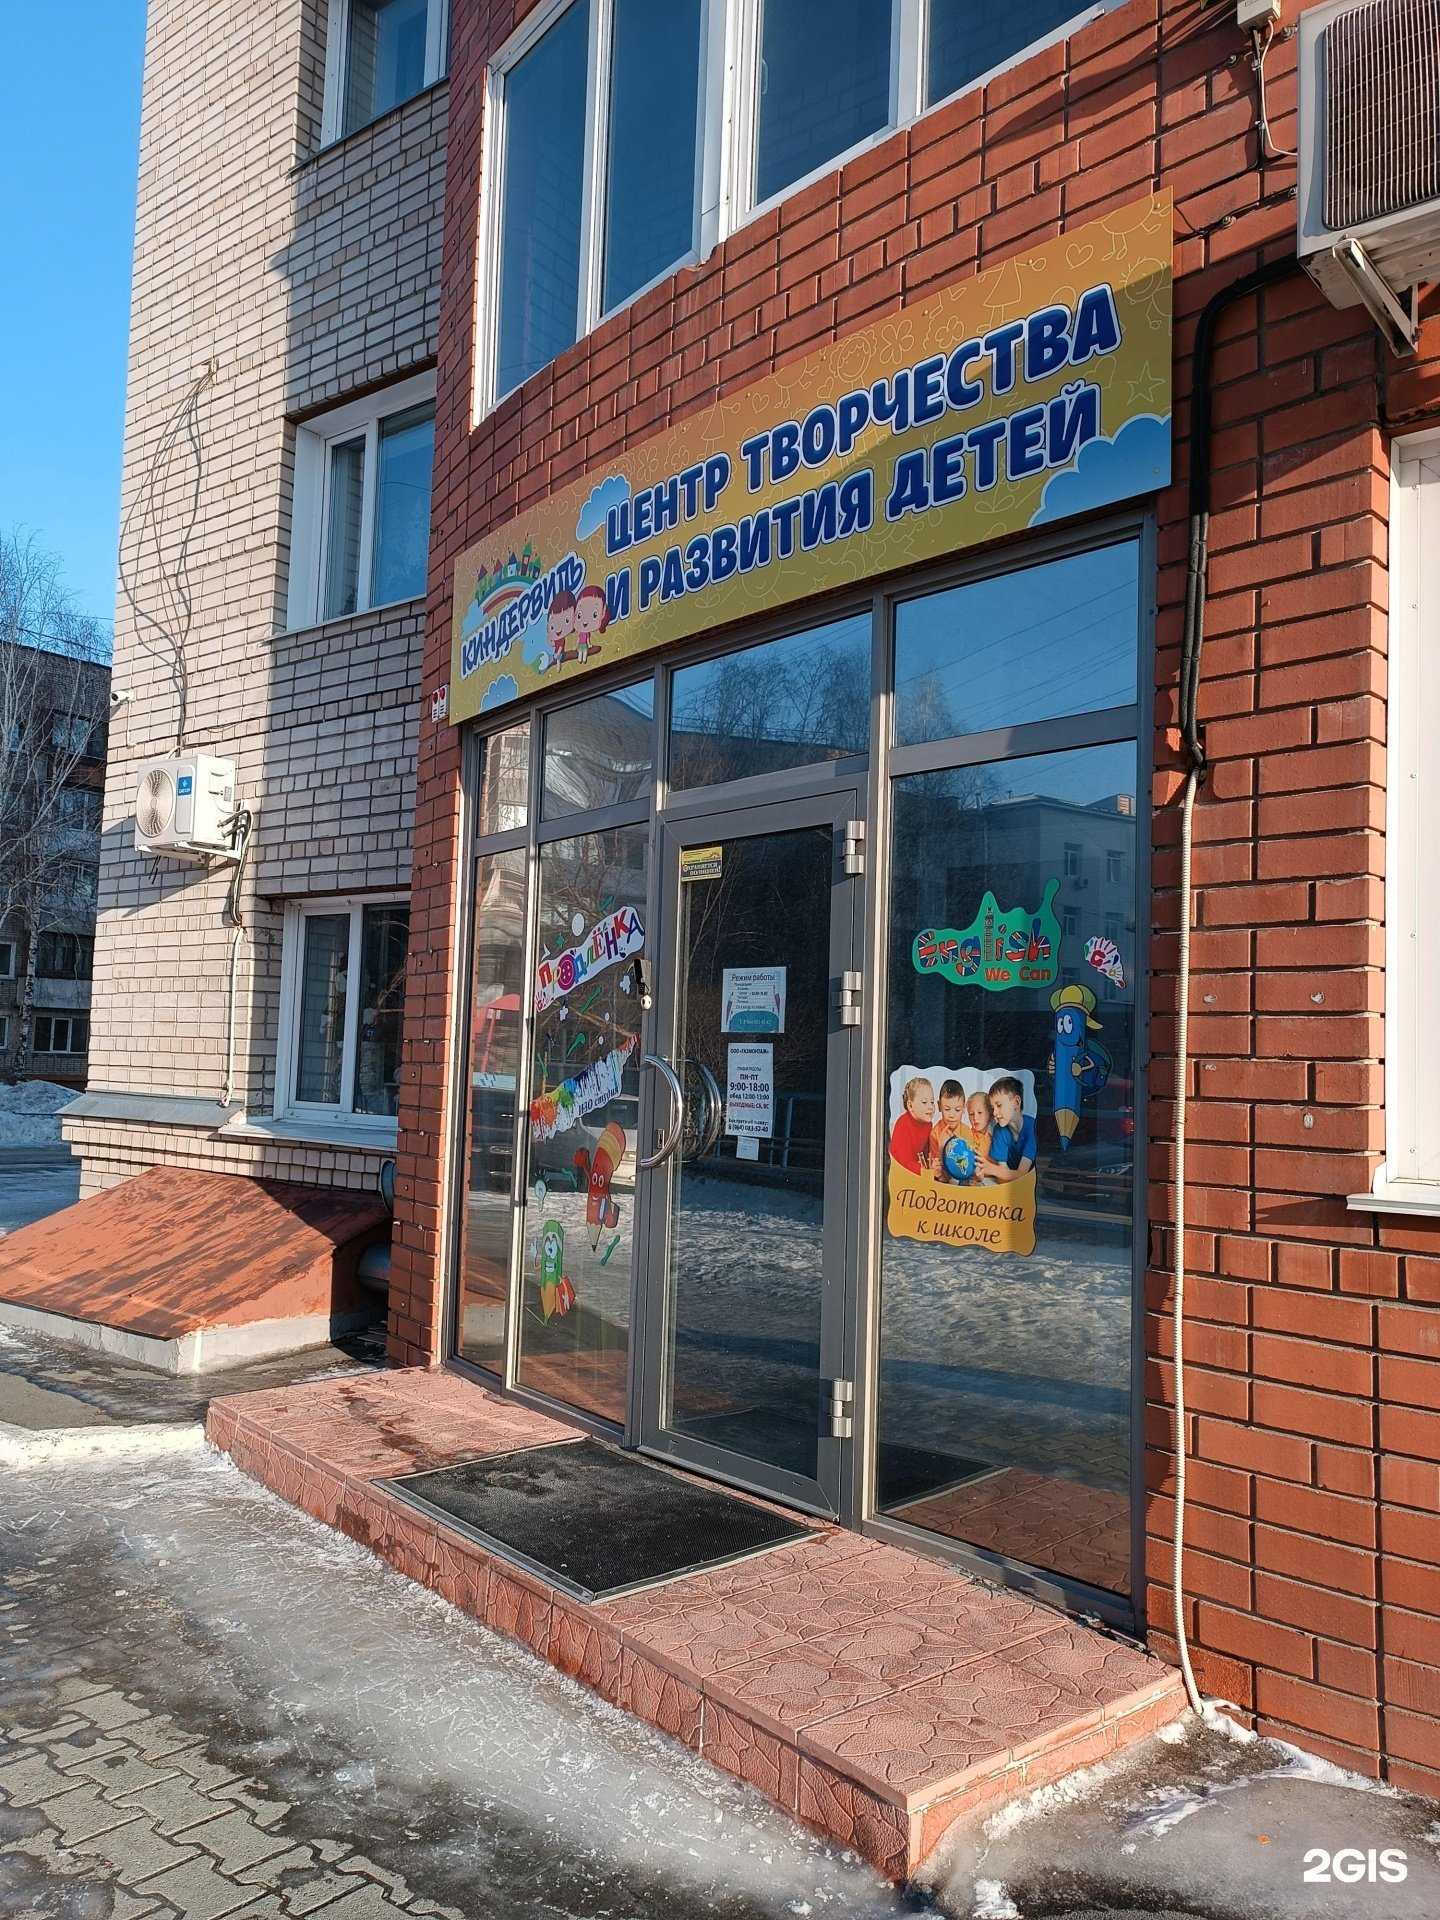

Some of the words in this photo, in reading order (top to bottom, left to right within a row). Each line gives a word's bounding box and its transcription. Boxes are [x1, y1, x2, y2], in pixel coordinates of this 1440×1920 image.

[606, 453, 731, 558] ЦЕНТР
[740, 282, 1122, 493] ТВОРЧЕСТВА
[605, 567, 631, 625] И
[638, 467, 874, 612] РАЗВИТИЯ
[885, 379, 1101, 522] ДЕТЕЙ
[917, 907, 1051, 977] English
[984, 967, 1011, 982] We
[1019, 966, 1051, 982] Can
[579, 1099, 593, 1116] ИЗО
[594, 1088, 619, 1107] студия
[729, 1082, 770, 1093] 9:00-18:00
[897, 1189, 1026, 1222] Подготовка
[917, 1220, 929, 1234] к
[933, 1221, 1002, 1244] школе
